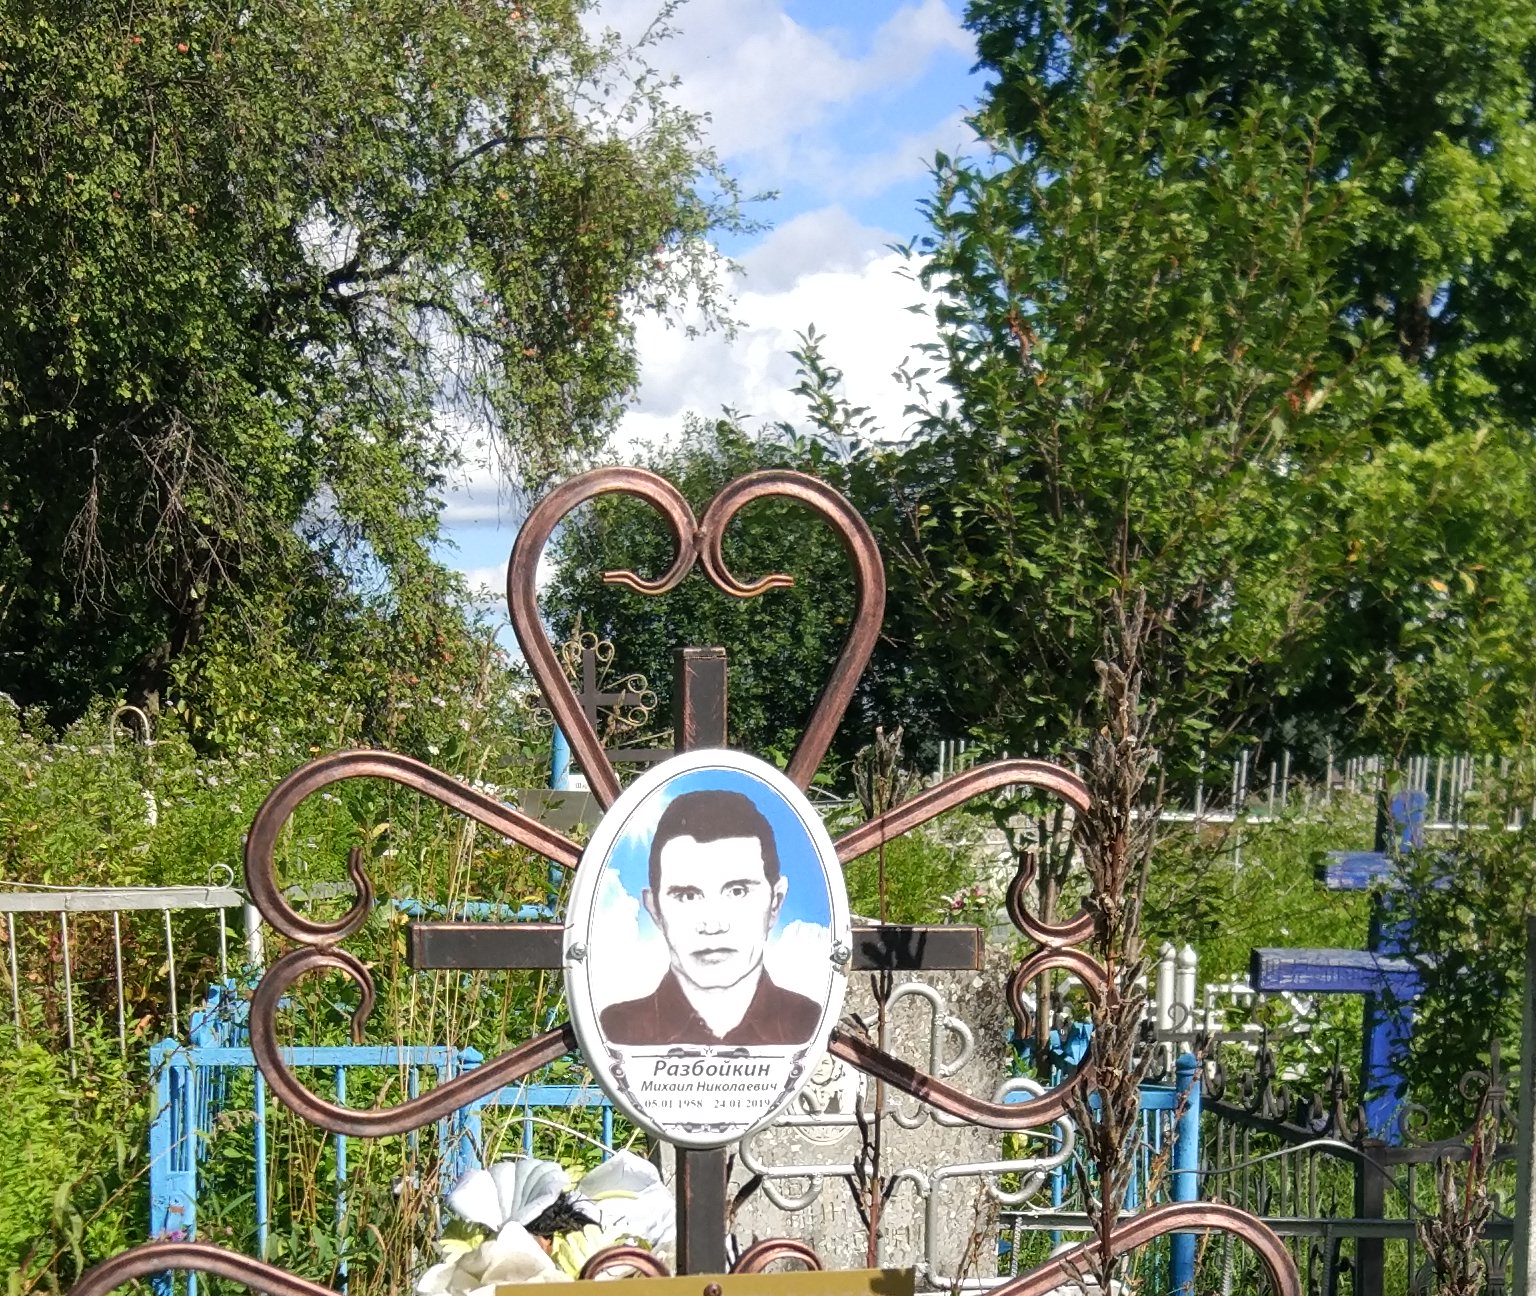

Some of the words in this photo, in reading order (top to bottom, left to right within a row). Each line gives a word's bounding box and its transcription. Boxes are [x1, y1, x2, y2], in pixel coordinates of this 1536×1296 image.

[653, 1058, 771, 1077] Разбойкин
[640, 1080, 694, 1092] Михаил
[696, 1080, 778, 1092] Николаевич
